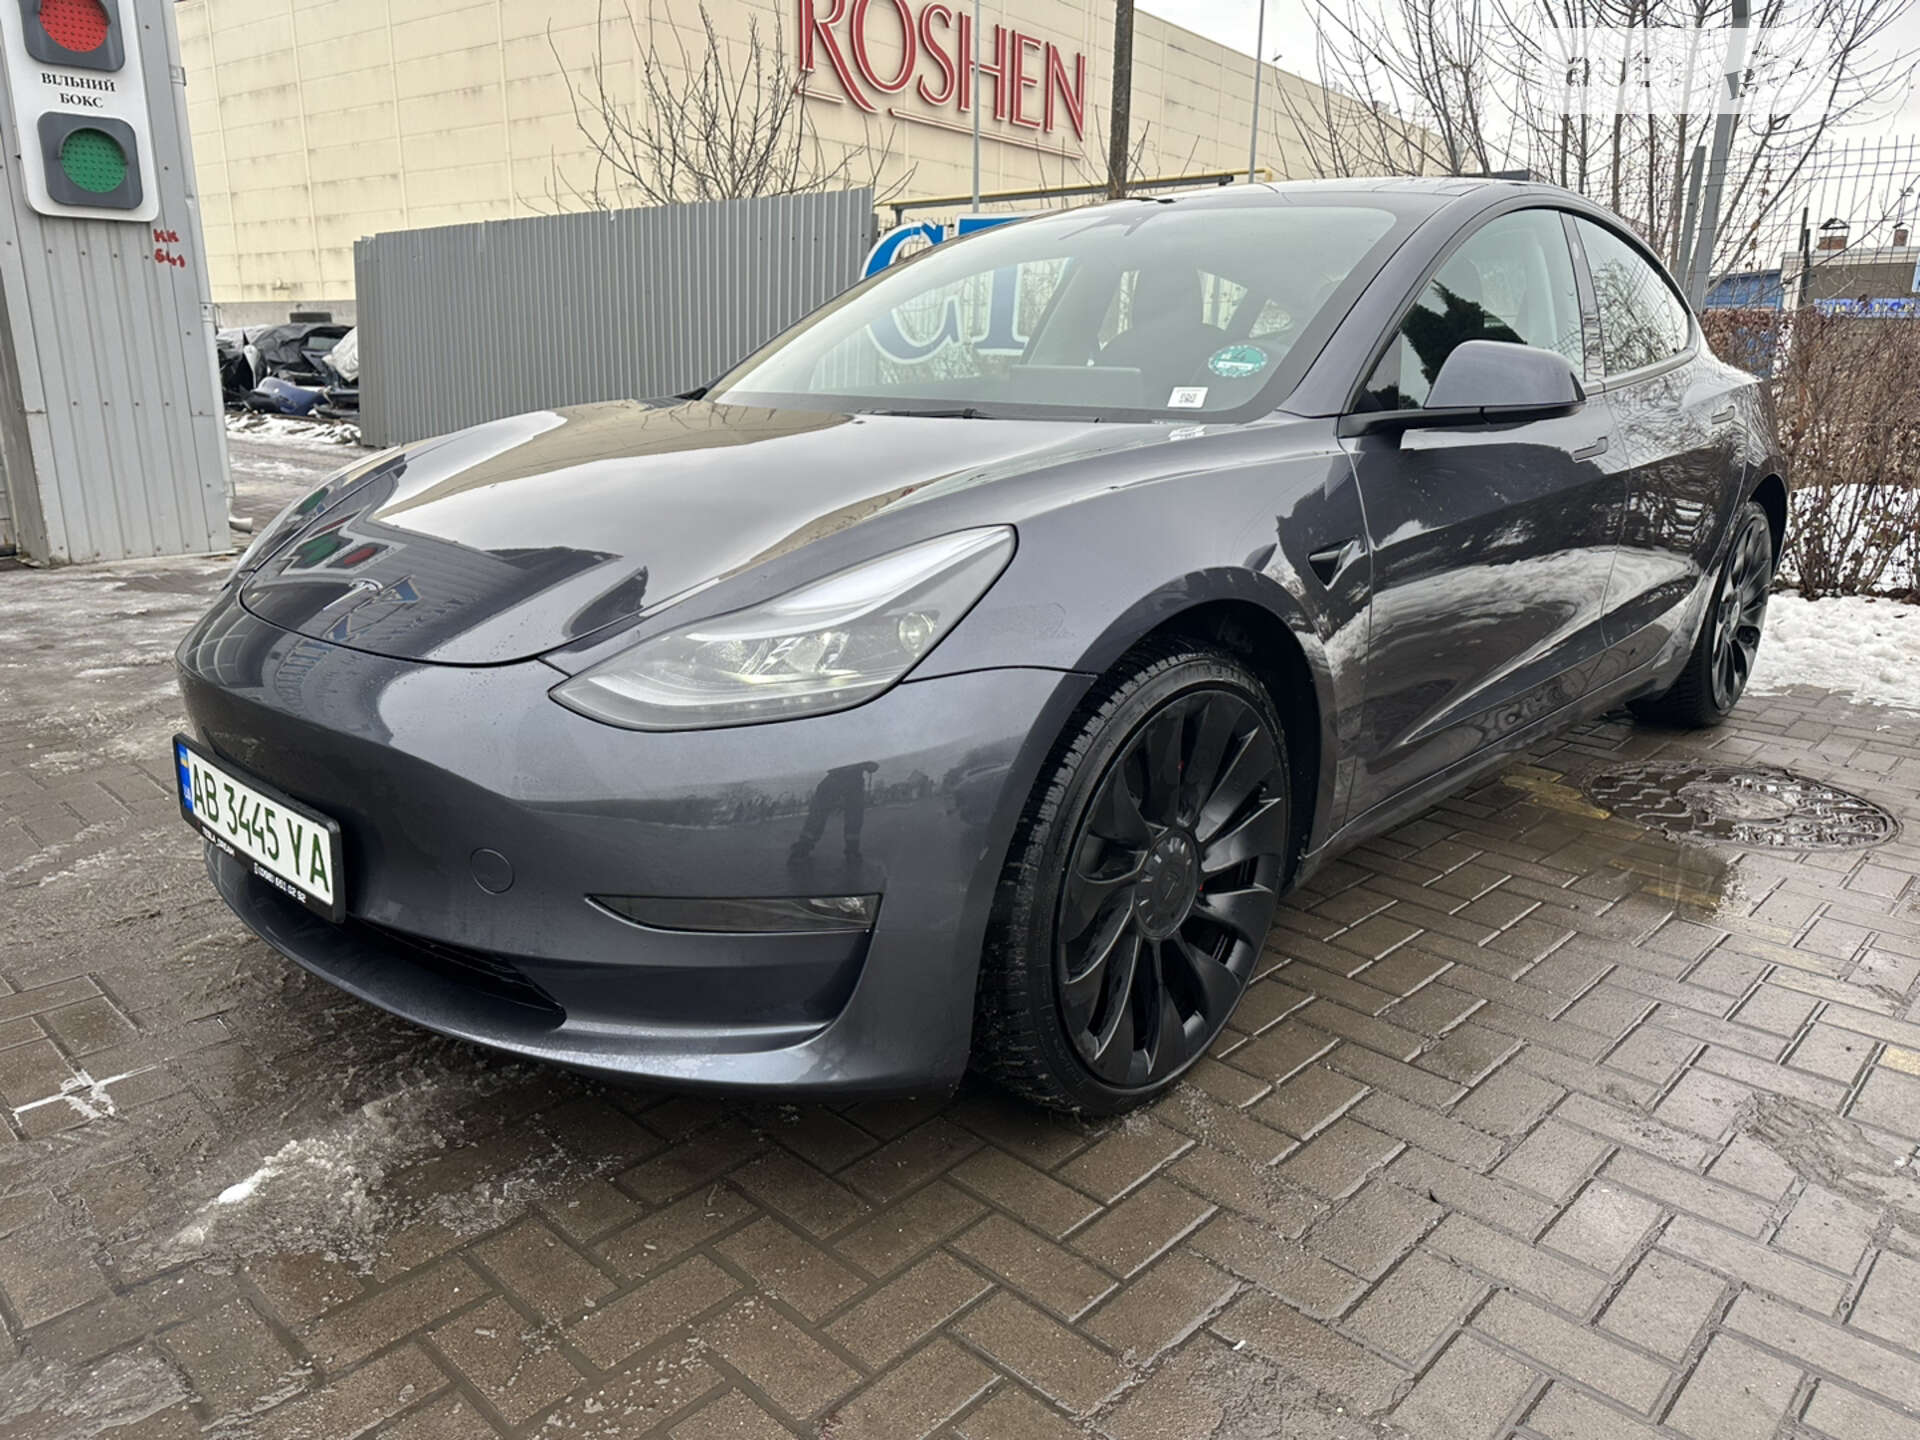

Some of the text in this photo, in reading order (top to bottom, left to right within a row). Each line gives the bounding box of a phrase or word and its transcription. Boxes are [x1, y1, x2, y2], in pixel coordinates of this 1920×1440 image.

[41, 72, 116, 92] ВІЛЬНИЙ
[59, 93, 104, 109] БОКС
[798, 0, 1086, 142] ROSHEN
[193, 764, 330, 893] AB 3445 YA
